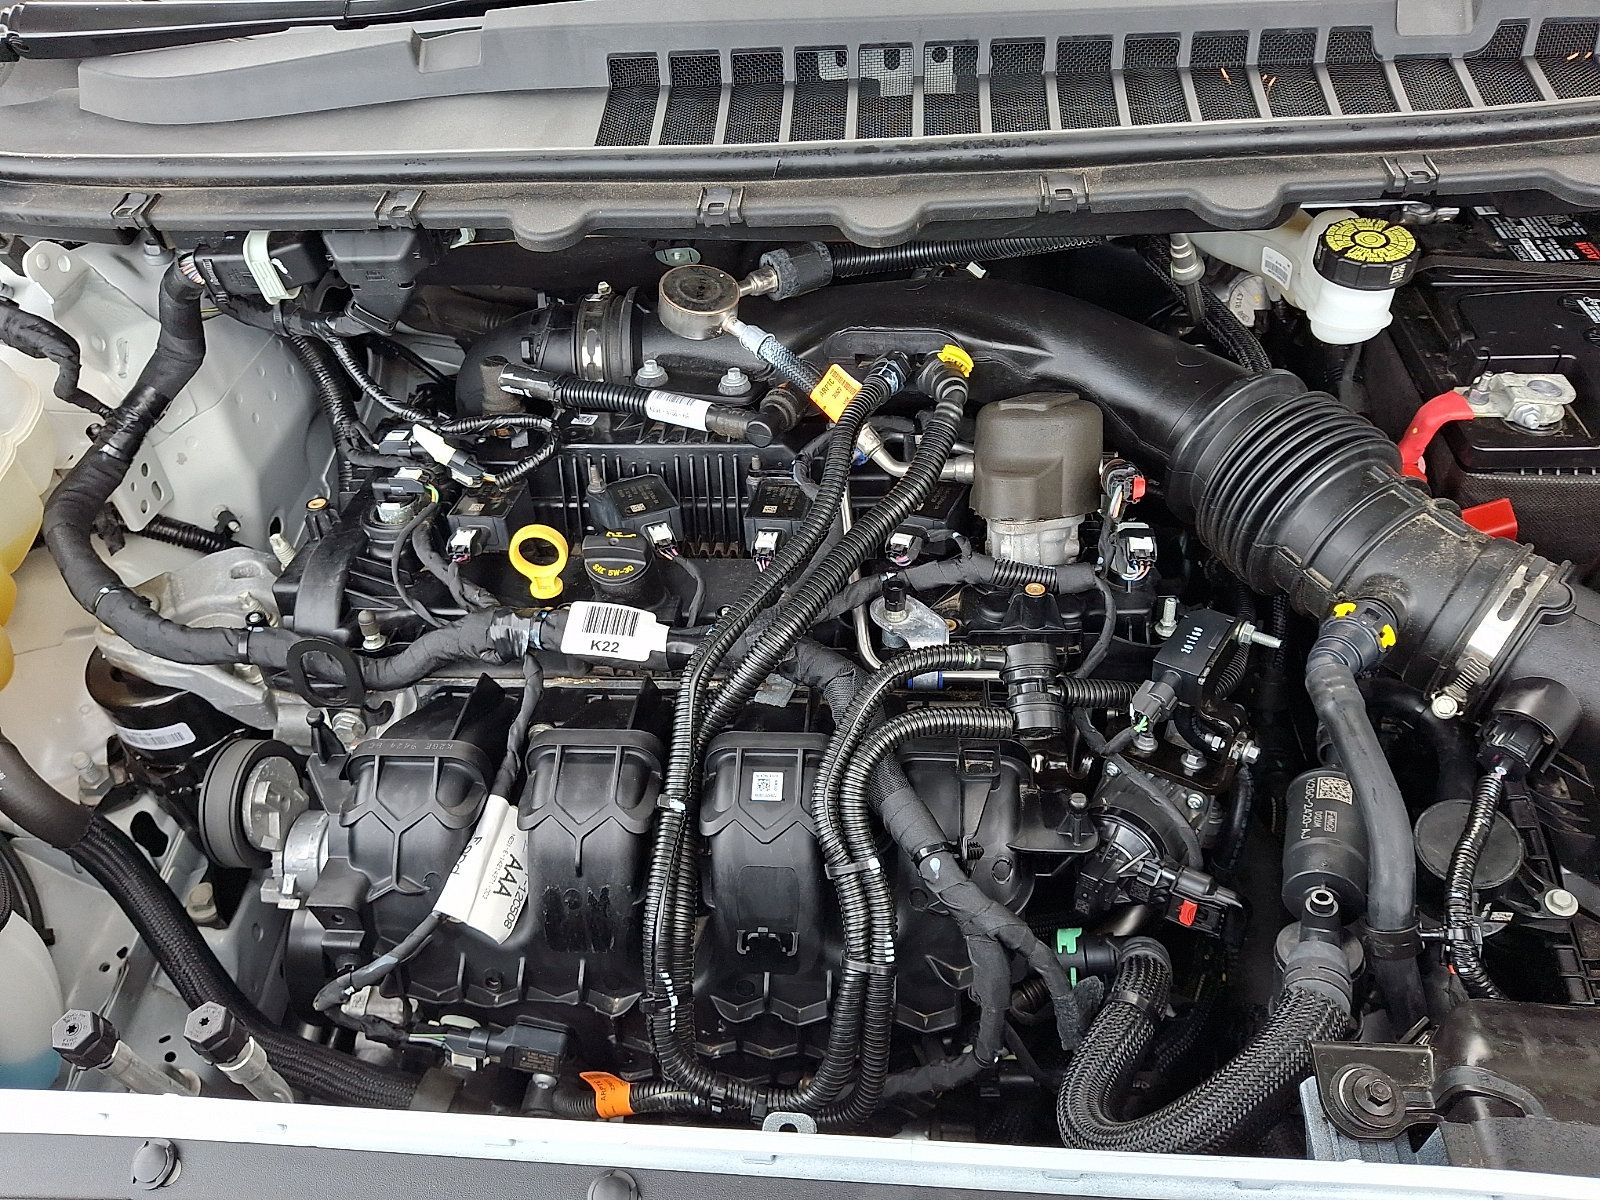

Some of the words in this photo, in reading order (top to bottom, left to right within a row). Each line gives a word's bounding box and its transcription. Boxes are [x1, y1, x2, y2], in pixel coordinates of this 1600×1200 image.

[592, 563, 607, 575] SAE
[607, 564, 634, 577] 5W-30
[590, 640, 619, 653] K22
[493, 853, 524, 898] AAA
